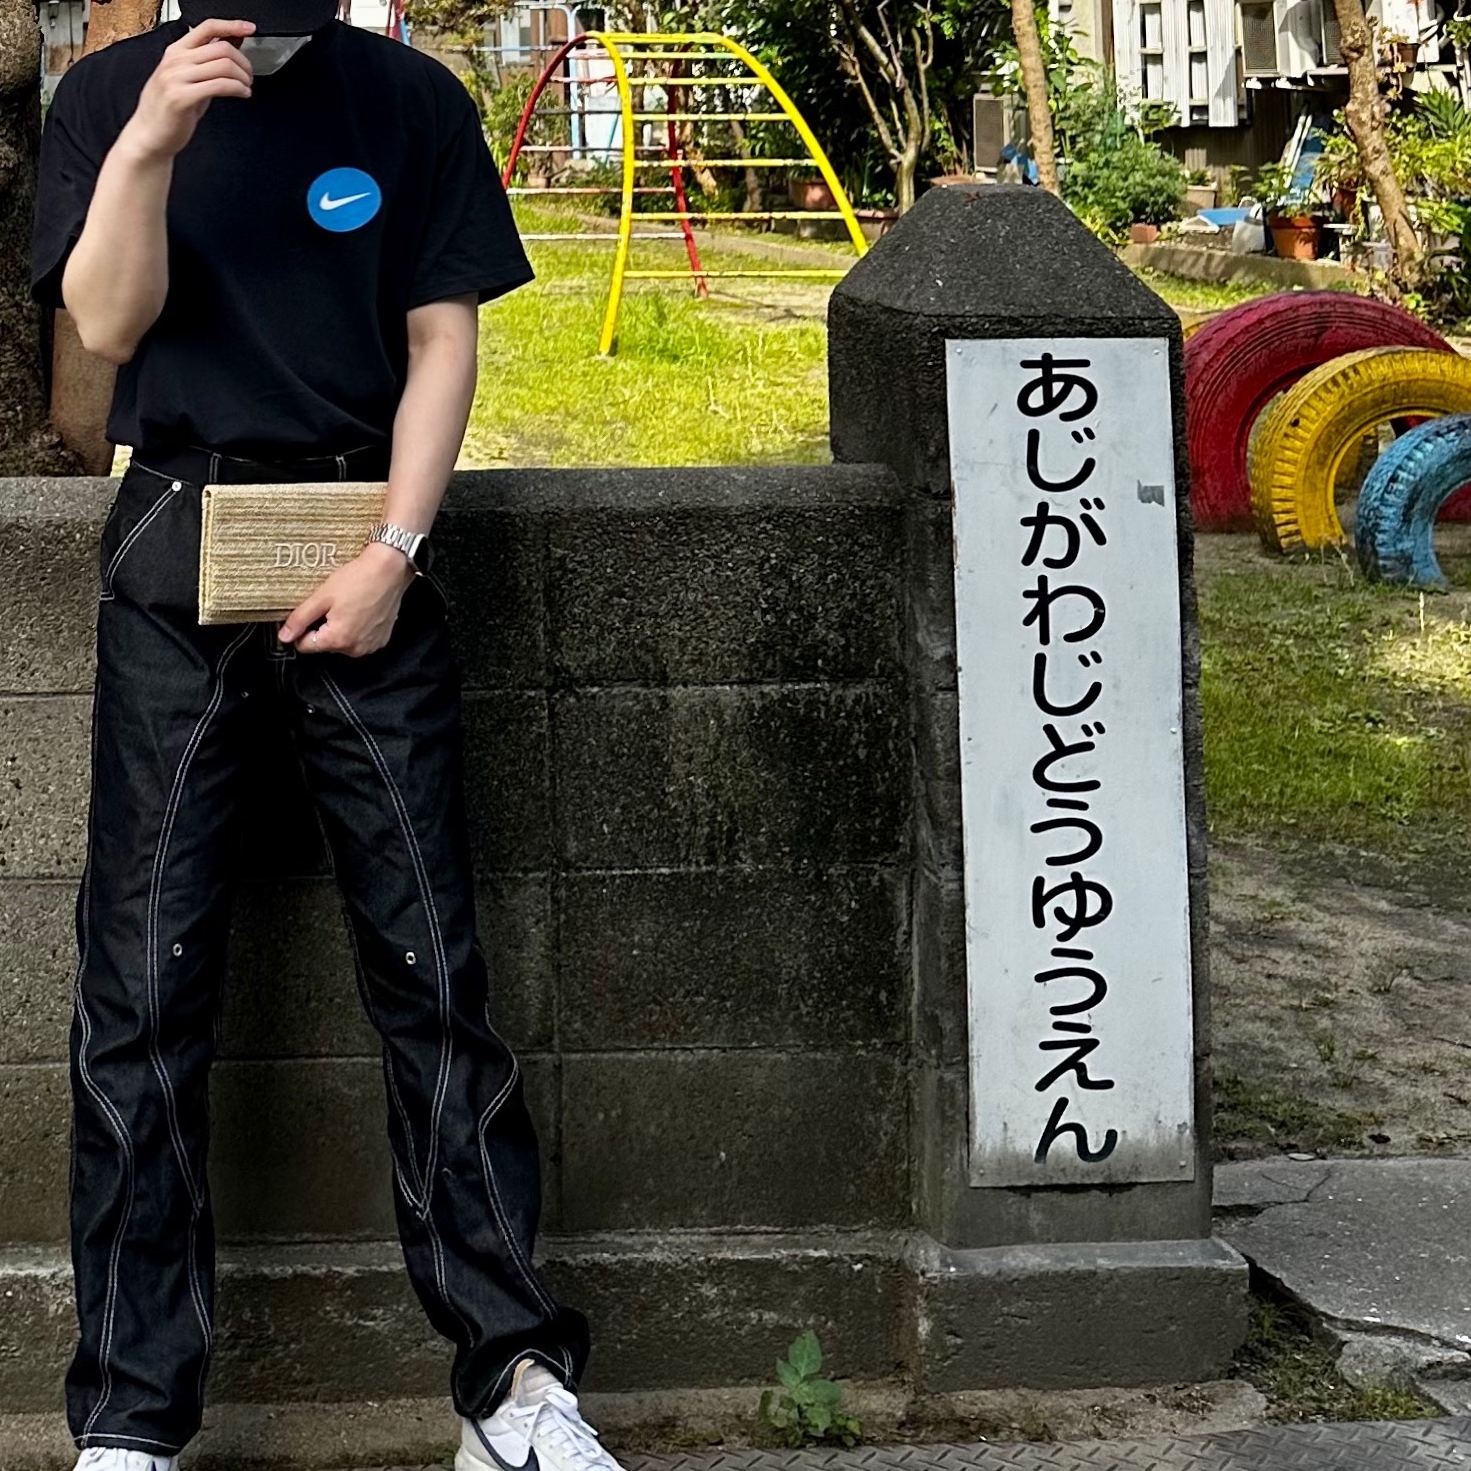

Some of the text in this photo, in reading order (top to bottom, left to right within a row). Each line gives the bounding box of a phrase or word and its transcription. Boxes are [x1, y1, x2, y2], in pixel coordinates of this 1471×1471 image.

[274, 542, 338, 568] DIOR
[1017, 353, 1118, 1164] あじがわじどうゆうえん
